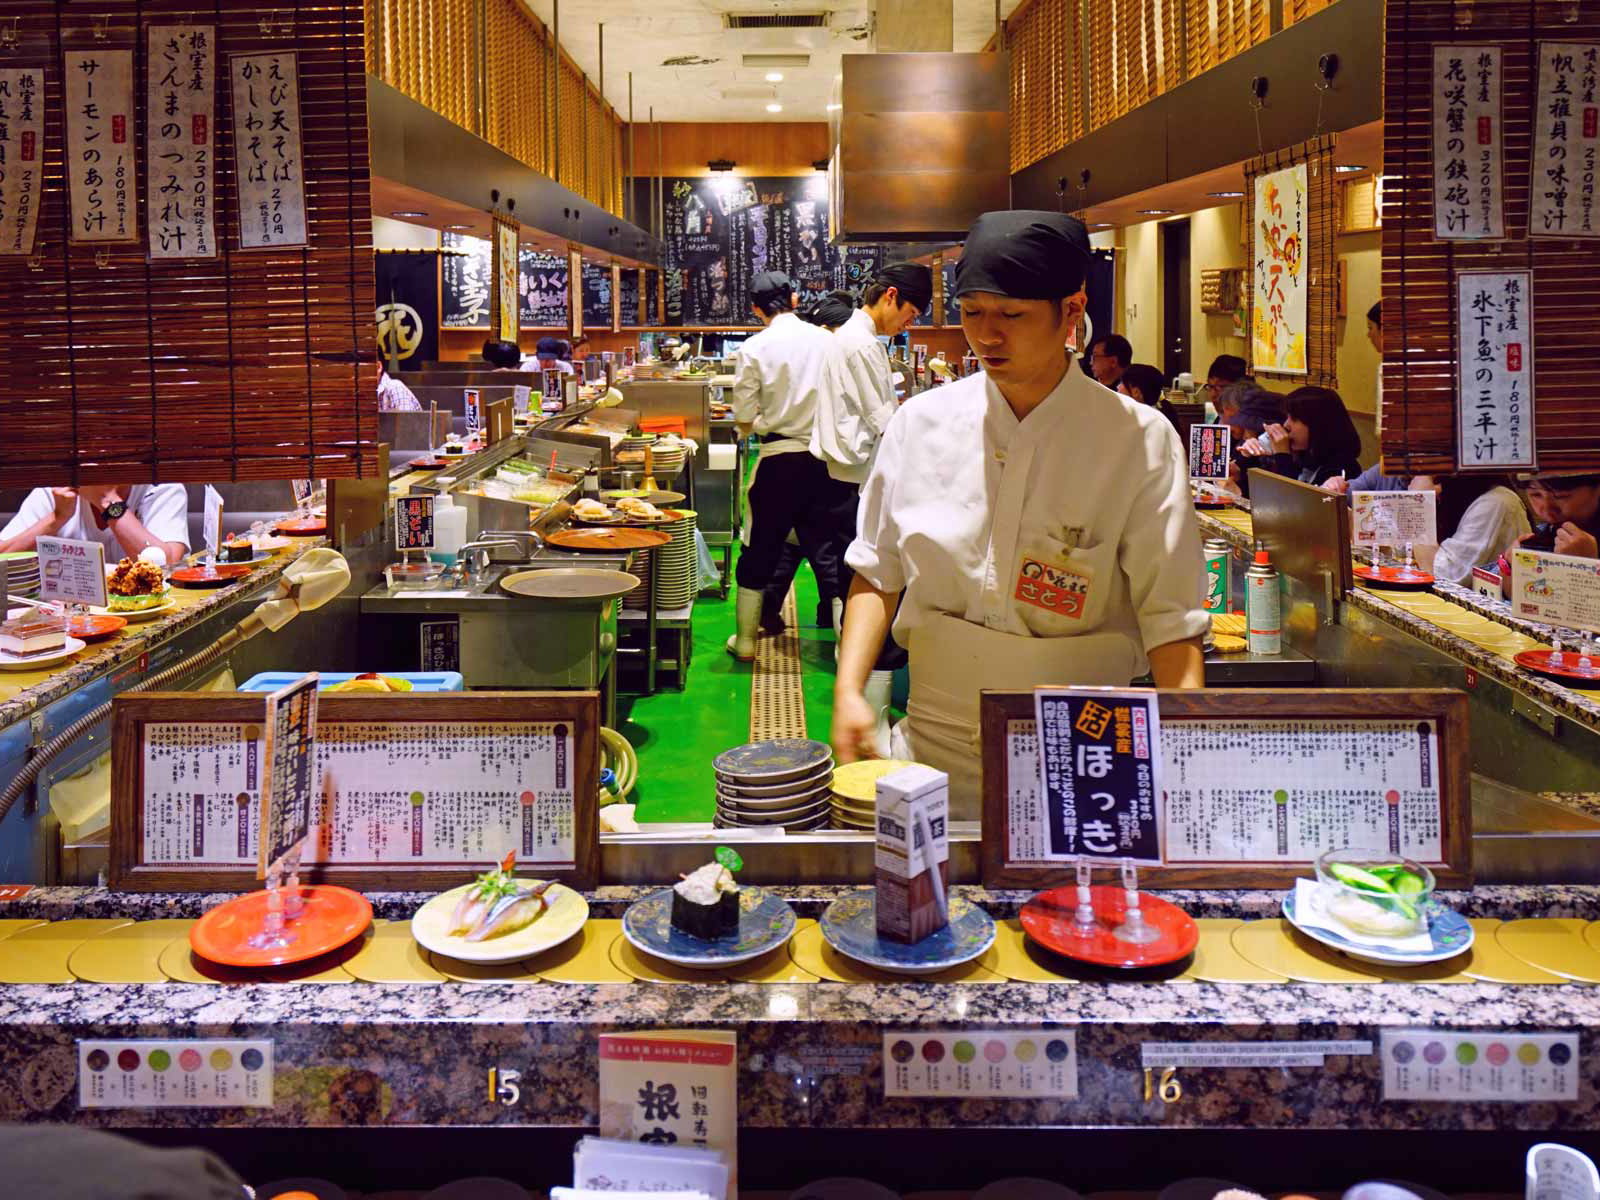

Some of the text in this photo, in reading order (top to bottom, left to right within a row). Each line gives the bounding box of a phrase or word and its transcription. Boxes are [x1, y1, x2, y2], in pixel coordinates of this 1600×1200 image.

[79, 60, 107, 232] サーモンのあら汁
[1503, 279, 1520, 330] 根室産
[1471, 290, 1498, 460] 氷下魚の三平汁
[1021, 583, 1079, 613] さとう
[1078, 701, 1112, 739] 活
[1077, 744, 1118, 853] ほっき
[487, 1067, 522, 1106] 15
[1143, 1066, 1183, 1104] 16
